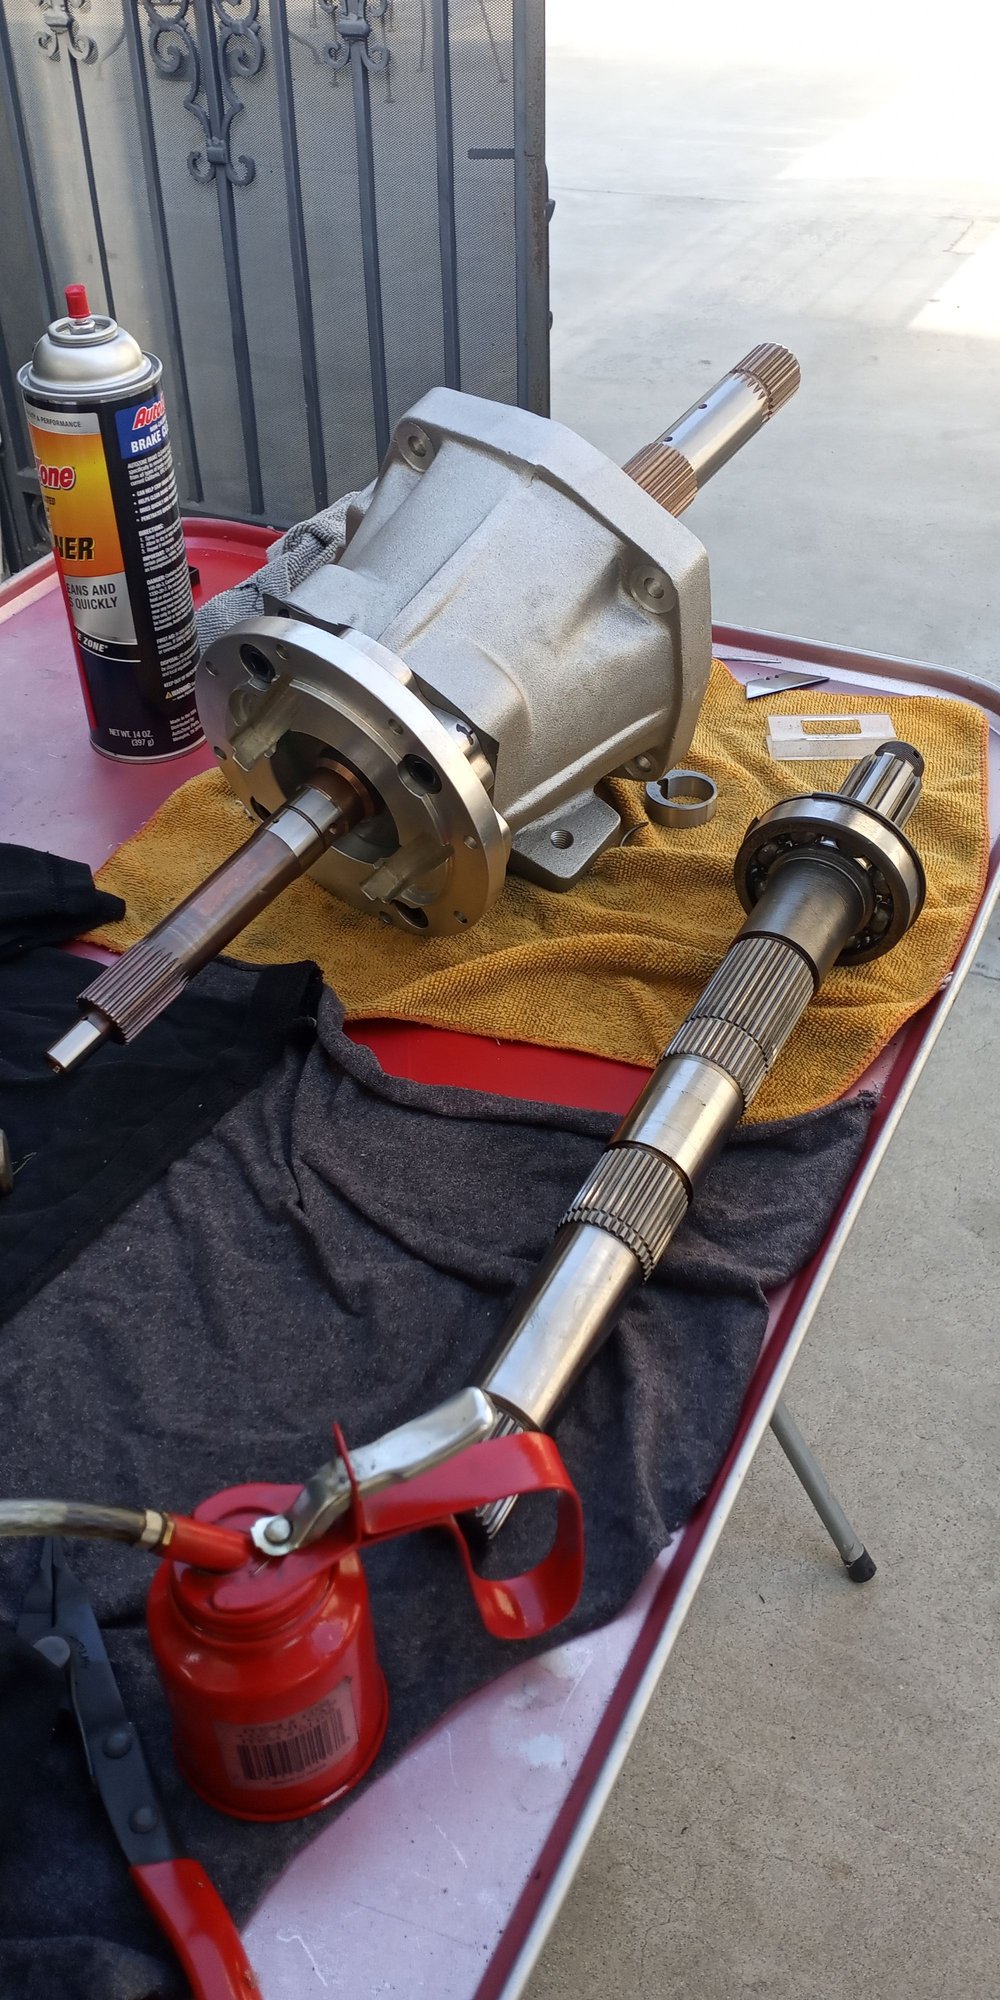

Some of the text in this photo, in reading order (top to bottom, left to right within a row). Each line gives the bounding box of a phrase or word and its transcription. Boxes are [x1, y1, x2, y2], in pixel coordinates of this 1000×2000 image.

[40, 416, 82, 428] PERFORMANCE
[130, 430, 162, 453] BRAKE
[92, 583, 116, 596] AND
[75, 596, 118, 610] QUICKLY
[83, 637, 106, 652] ZONE
[109, 728, 120, 736] NET
[131, 738, 154, 747] (397 g)
